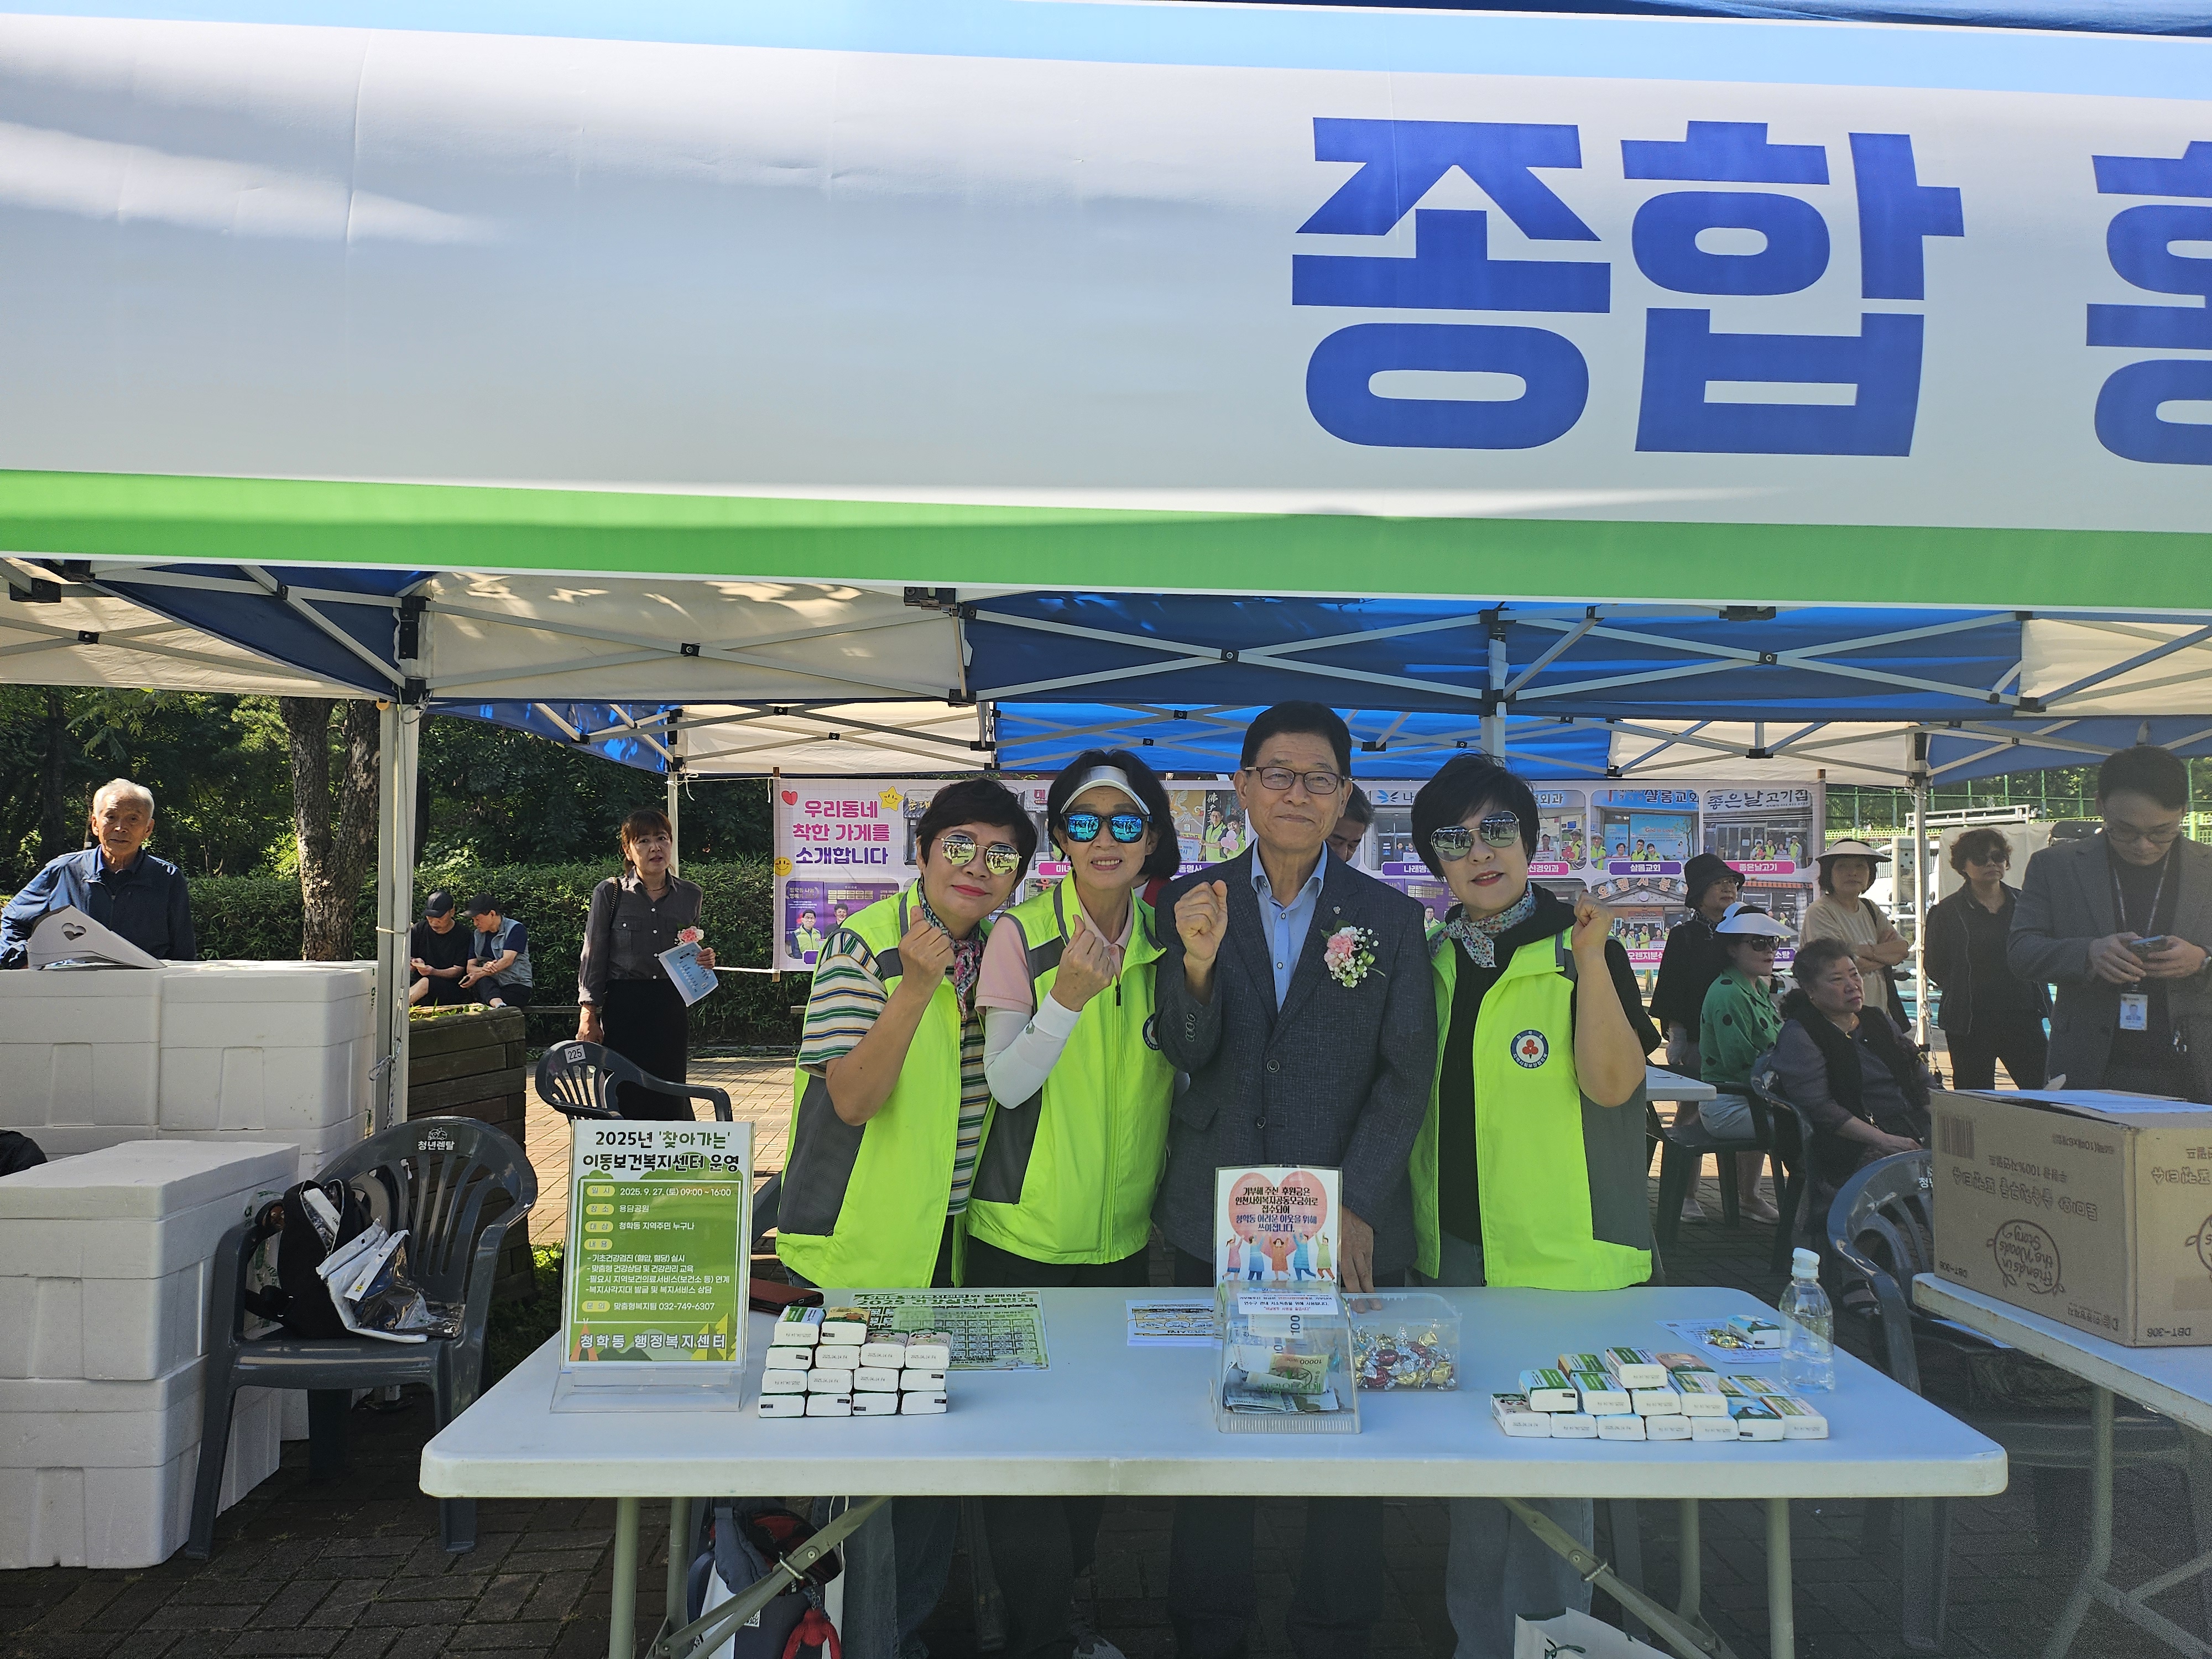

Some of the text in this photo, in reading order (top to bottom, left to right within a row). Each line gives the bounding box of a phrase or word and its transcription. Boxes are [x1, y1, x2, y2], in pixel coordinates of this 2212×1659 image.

[1292, 116, 1964, 457] 종합
[1707, 789, 1808, 810] 좋은날 고기집
[805, 800, 878, 818] 우리동네
[792, 823, 890, 842] 착한 가게를
[796, 847, 889, 865] 소개합니다
[1630, 863, 1661, 873] 샬롬교회
[1739, 863, 1777, 872] 좋은날고기
[567, 1050, 583, 1060] 225
[596, 1130, 731, 1149] 2025년 '찾아가는'
[418, 1140, 455, 1150] 청년렌탈
[583, 1154, 739, 1172] 이동보건복지센터 운영
[666, 1188, 679, 1196] (토)
[1243, 1187, 1310, 1196] 기부해 주신 후원금은
[1261, 1205, 1290, 1214] 접수되어
[1235, 1214, 1317, 1224] 청학동 어려운 이웃을 위해
[642, 1222, 671, 1230] 지역주민
[672, 1222, 695, 1230] 누구나
[592, 1254, 633, 1262] 기초건강검진
[654, 1254, 670, 1263] 혈당)
[592, 1265, 613, 1273] 맞춤형
[614, 1265, 642, 1273] 건강상담
[643, 1265, 650, 1273] 및
[651, 1265, 679, 1273] 건강관리
[704, 1275, 714, 1284] 등)
[634, 1286, 649, 1294] 발굴
[651, 1286, 658, 1294] 및
[660, 1286, 696, 1294] 복지서비스
[697, 1286, 712, 1294] 상담
[614, 1302, 657, 1311] 맞춤형복지팀
[659, 1302, 714, 1311] 032-749-6307
[581, 1333, 726, 1349] 청학동 행정복지센터
